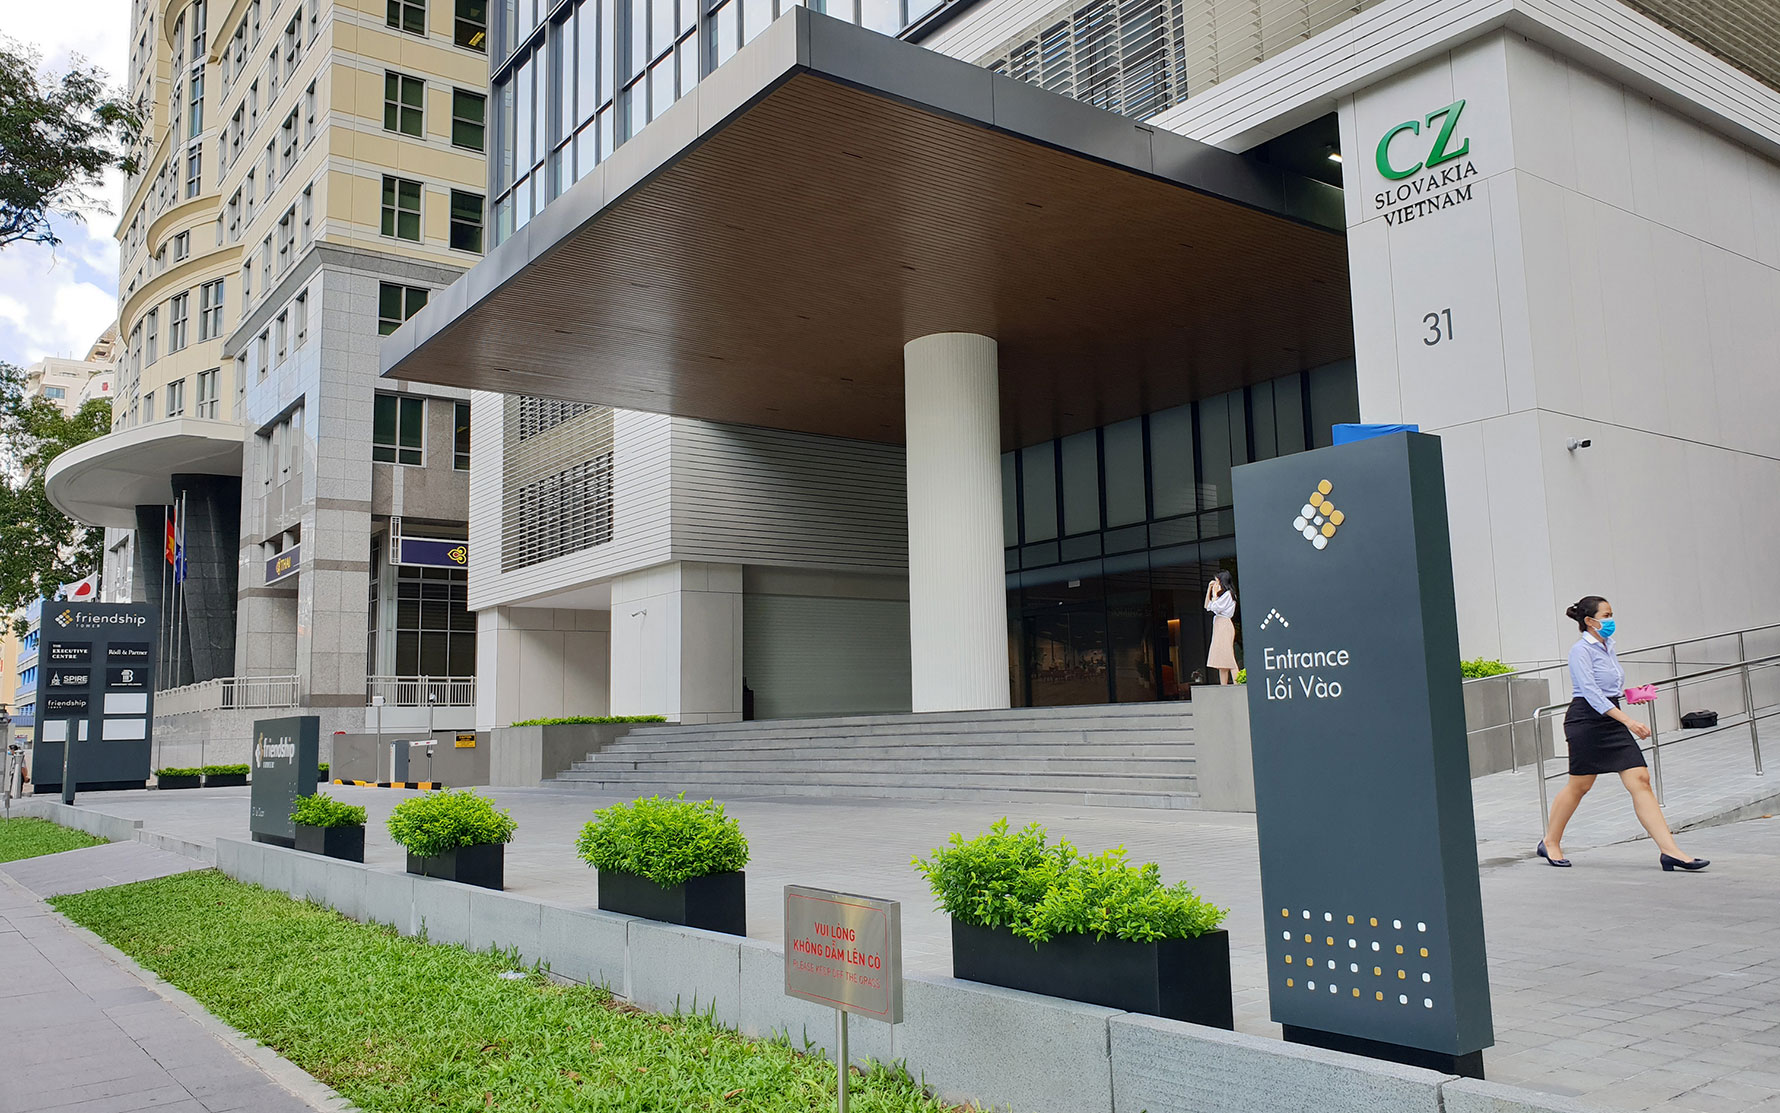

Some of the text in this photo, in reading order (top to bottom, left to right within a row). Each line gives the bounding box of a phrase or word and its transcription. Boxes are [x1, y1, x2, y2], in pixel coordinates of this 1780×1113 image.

[1375, 98, 1470, 181] CZ
[1374, 160, 1478, 210] SLOVAKIA
[1383, 183, 1473, 227] VIETNAM
[1422, 307, 1453, 346] 31
[76, 612, 146, 627] friendship
[1263, 647, 1350, 671] Entrance
[1265, 673, 1342, 700] Lối Vào
[48, 700, 86, 708] friendship
[263, 736, 296, 765] friendship
[814, 921, 829, 937] VUI
[793, 937, 823, 957] KHÔNG
[792, 959, 881, 989] PLEASE KEEP OFF THE GRASS
